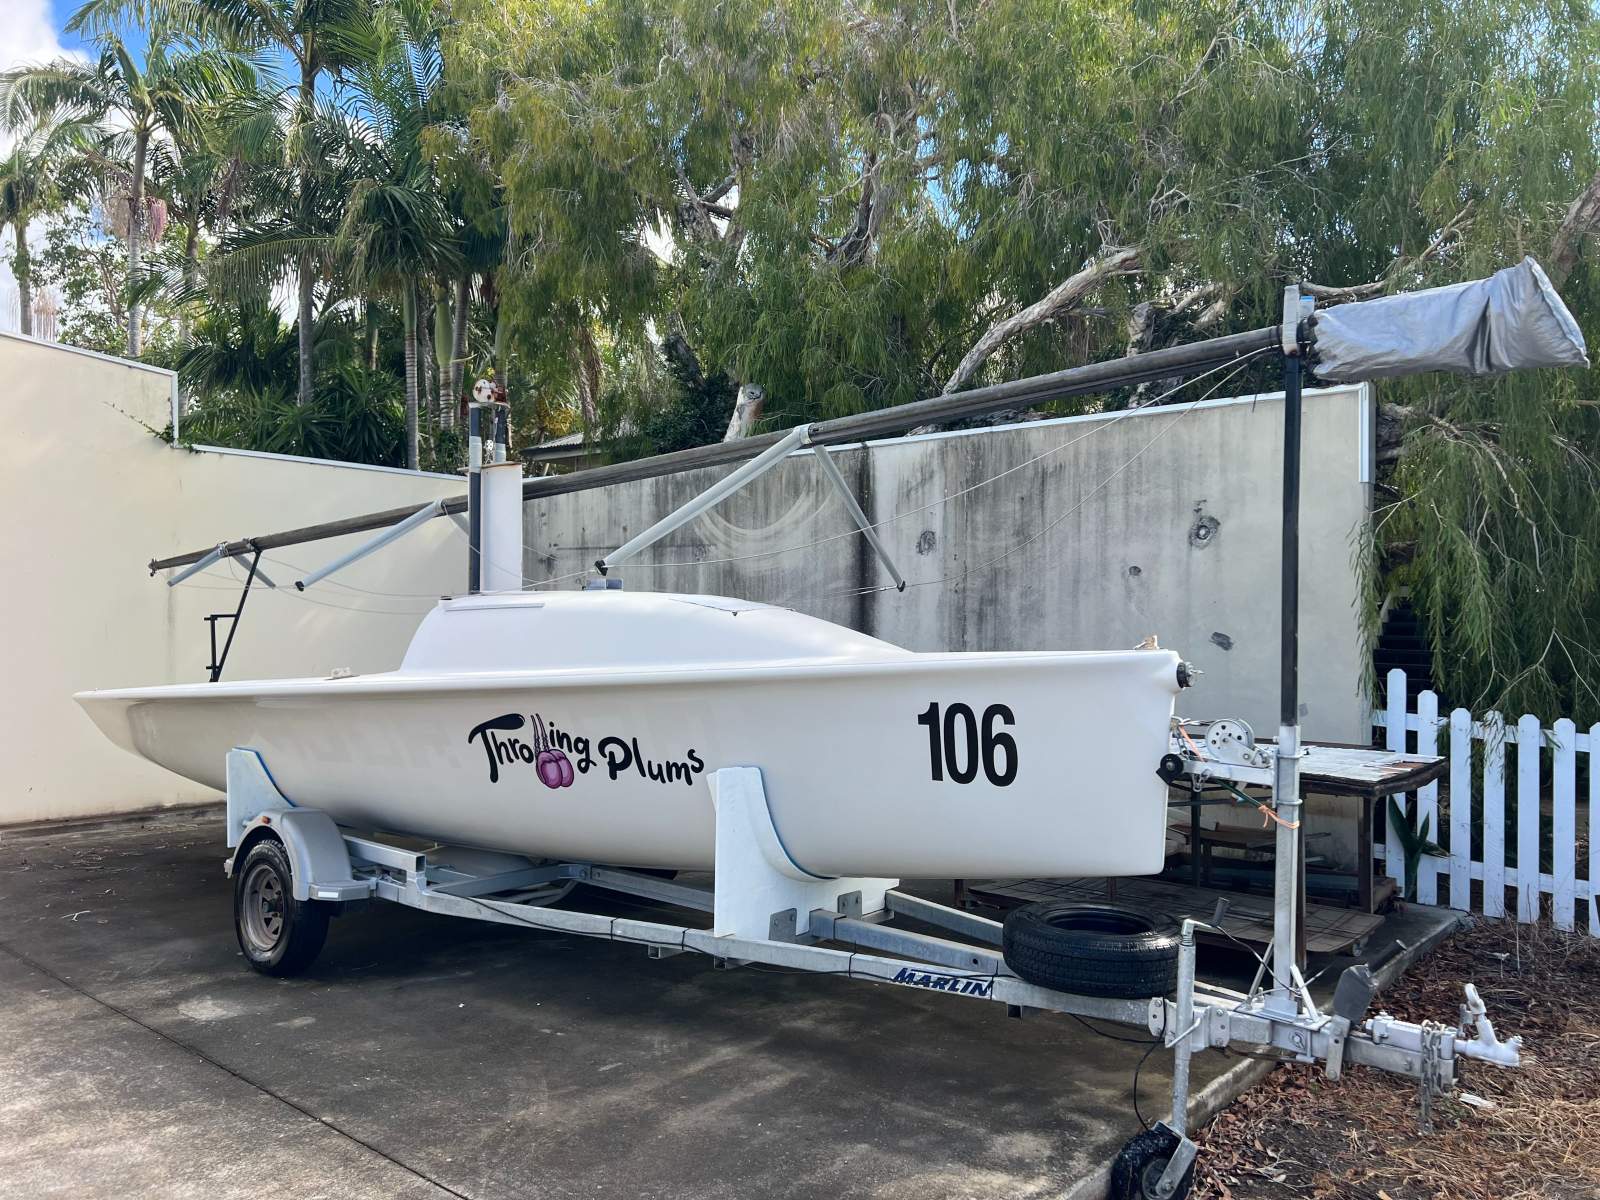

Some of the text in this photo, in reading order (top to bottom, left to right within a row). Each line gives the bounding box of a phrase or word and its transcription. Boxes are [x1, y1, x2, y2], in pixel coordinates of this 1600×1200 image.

[598, 736, 704, 785] Plums
[917, 702, 1018, 787] 106
[892, 967, 993, 997] MARLIN
